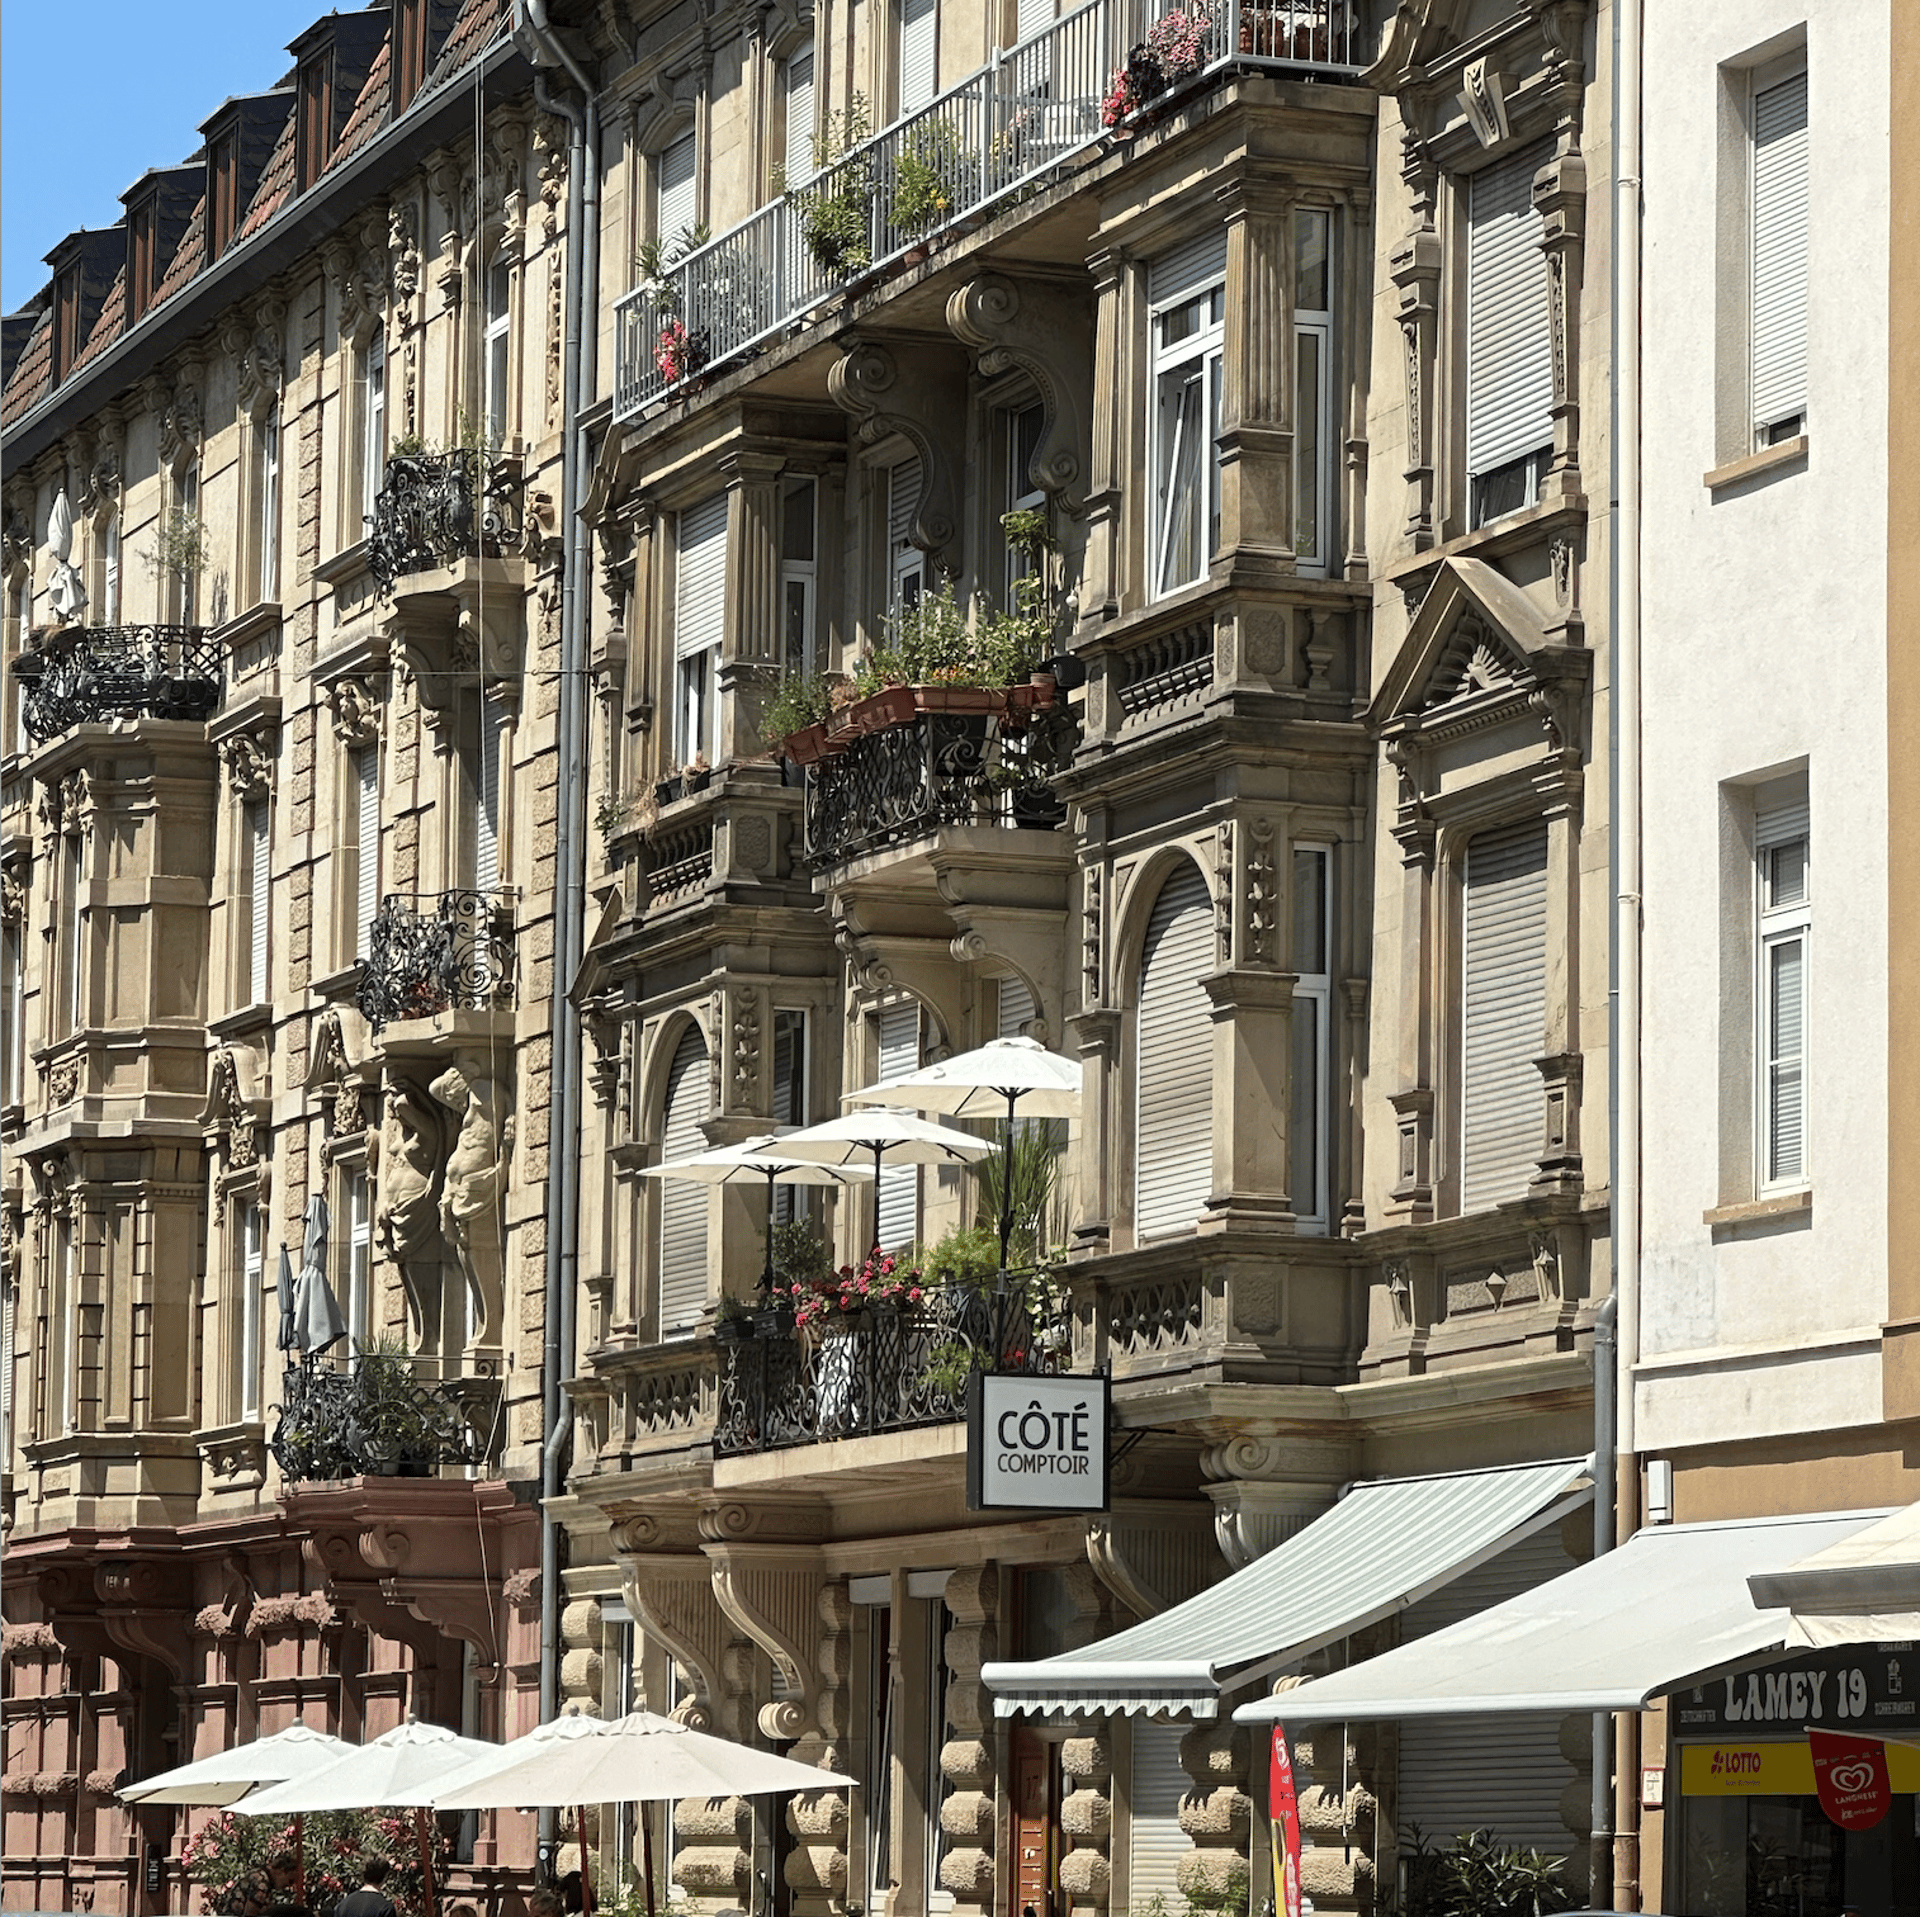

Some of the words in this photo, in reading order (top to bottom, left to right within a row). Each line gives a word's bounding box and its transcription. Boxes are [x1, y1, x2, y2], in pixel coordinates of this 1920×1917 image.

[998, 1400, 1089, 1451] CÔTÉ
[997, 1453, 1089, 1475] COMPTOIR
[1725, 1670, 1827, 1720] LAMEY
[1836, 1667, 1868, 1718] 19
[1726, 1752, 1761, 1773] LOTTO
[1026, 1775, 1039, 1800] 17
